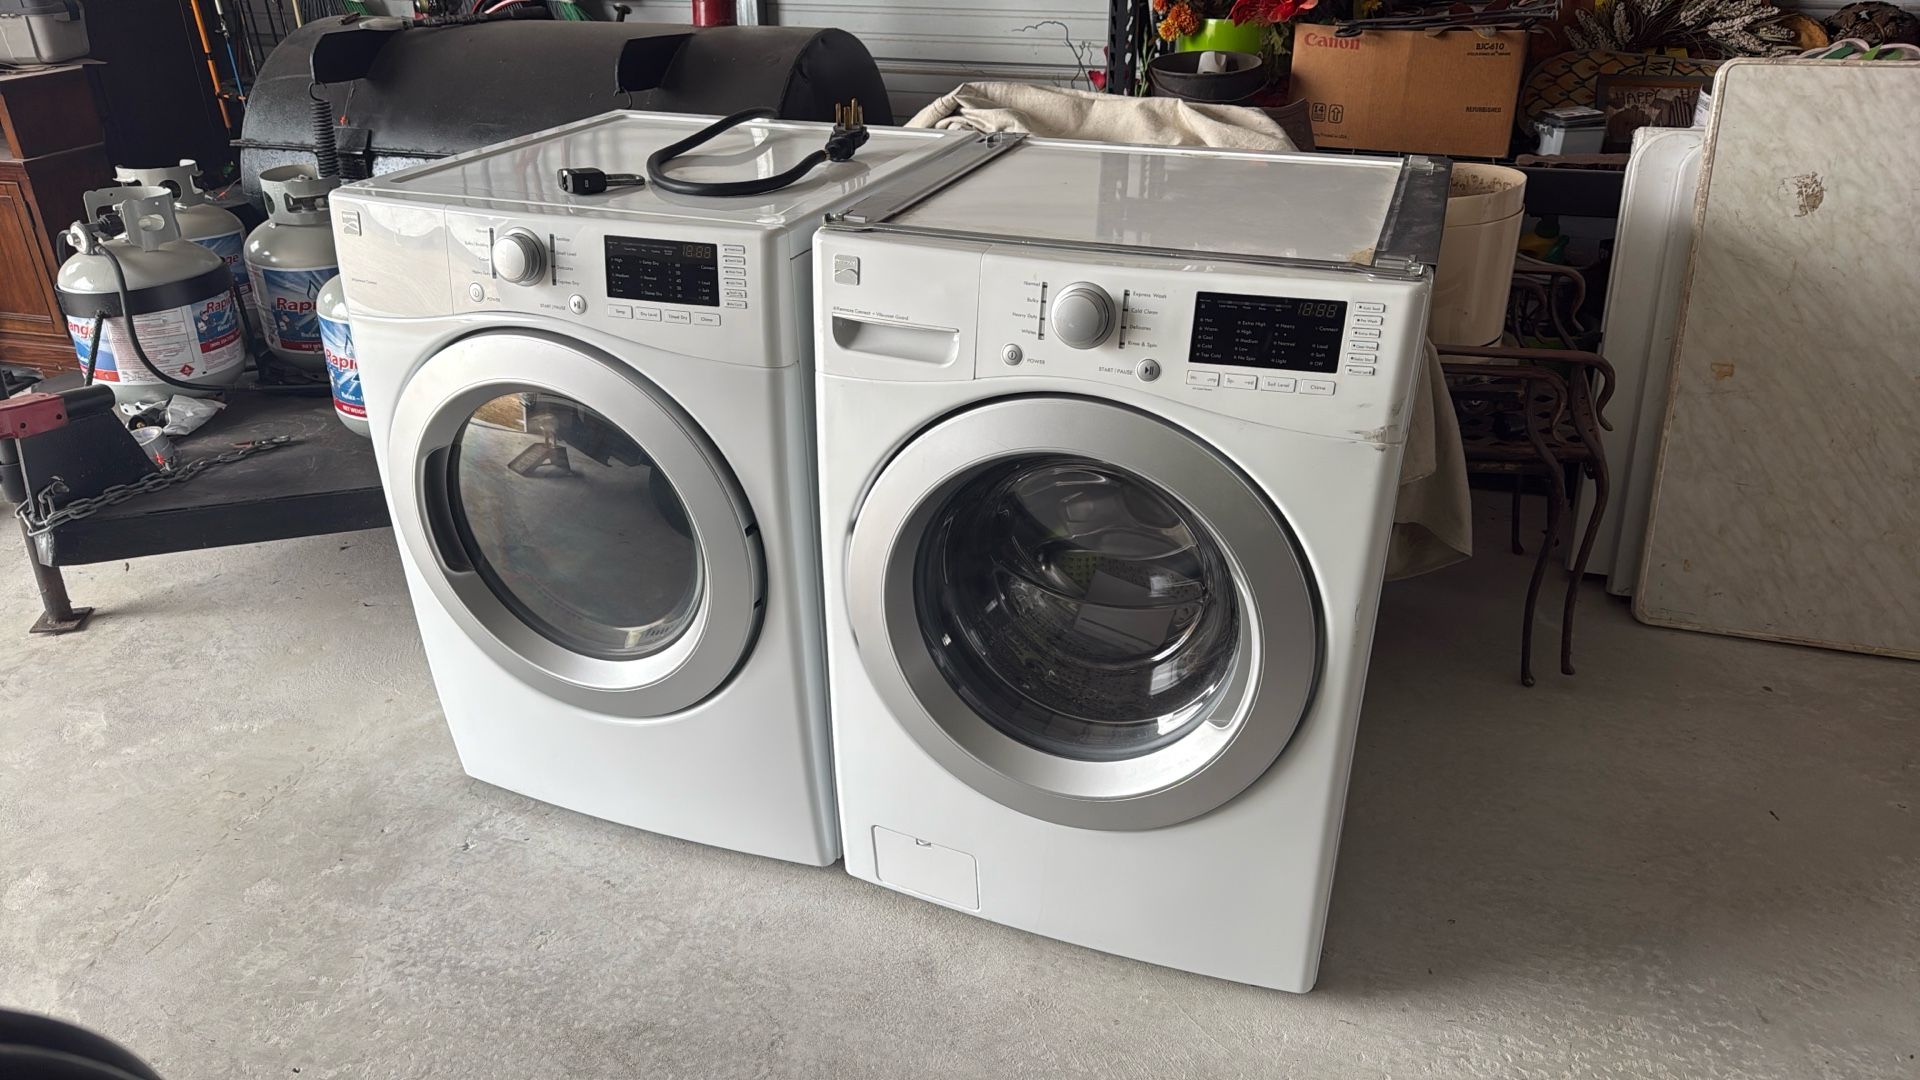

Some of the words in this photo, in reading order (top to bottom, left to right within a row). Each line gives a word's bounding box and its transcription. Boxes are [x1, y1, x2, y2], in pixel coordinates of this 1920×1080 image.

[1304, 32, 1361, 50] Canon
[1616, 88, 1661, 105] HAPPY
[1132, 291, 1151, 299] Express
[1026, 358, 1046, 366] POWER
